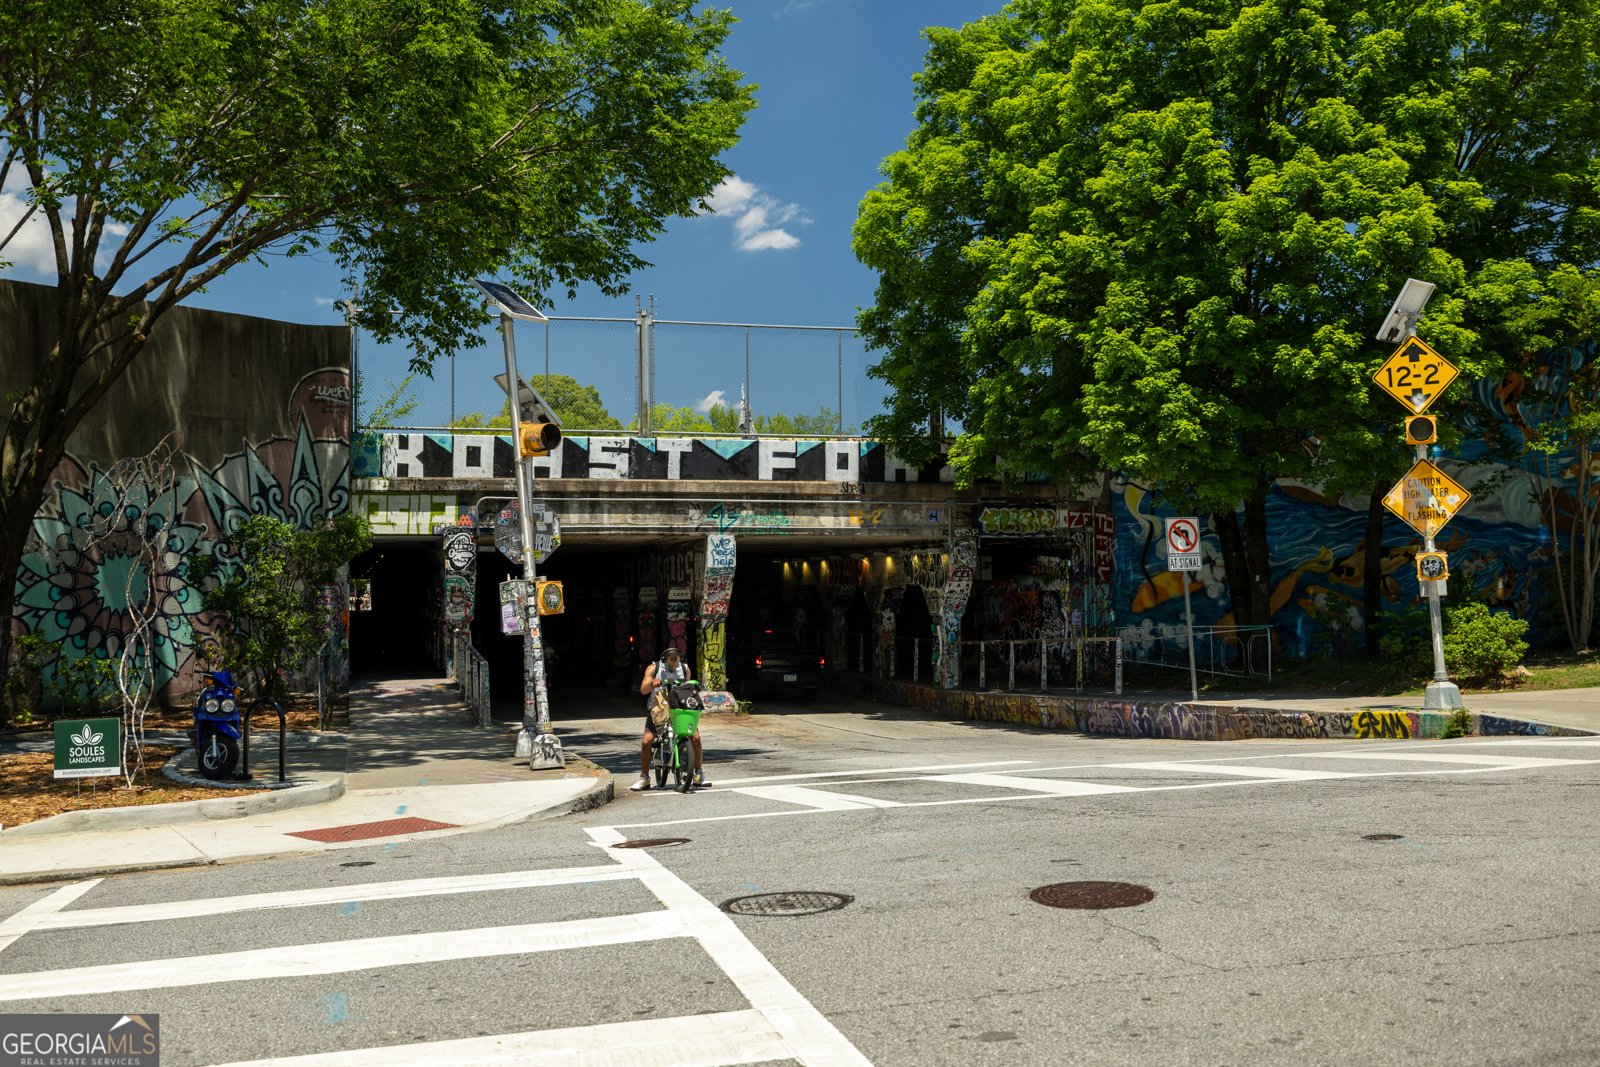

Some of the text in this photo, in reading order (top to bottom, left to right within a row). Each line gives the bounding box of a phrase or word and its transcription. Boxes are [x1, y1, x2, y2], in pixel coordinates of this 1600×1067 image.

[1408, 477, 1441, 488] CAUTION
[1422, 487, 1449, 498] ATER
[1408, 509, 1447, 521] FLASHING
[712, 555, 734, 568] help
[1171, 557, 1200, 568] AT SIGNAL
[69, 746, 105, 757] SOULES
